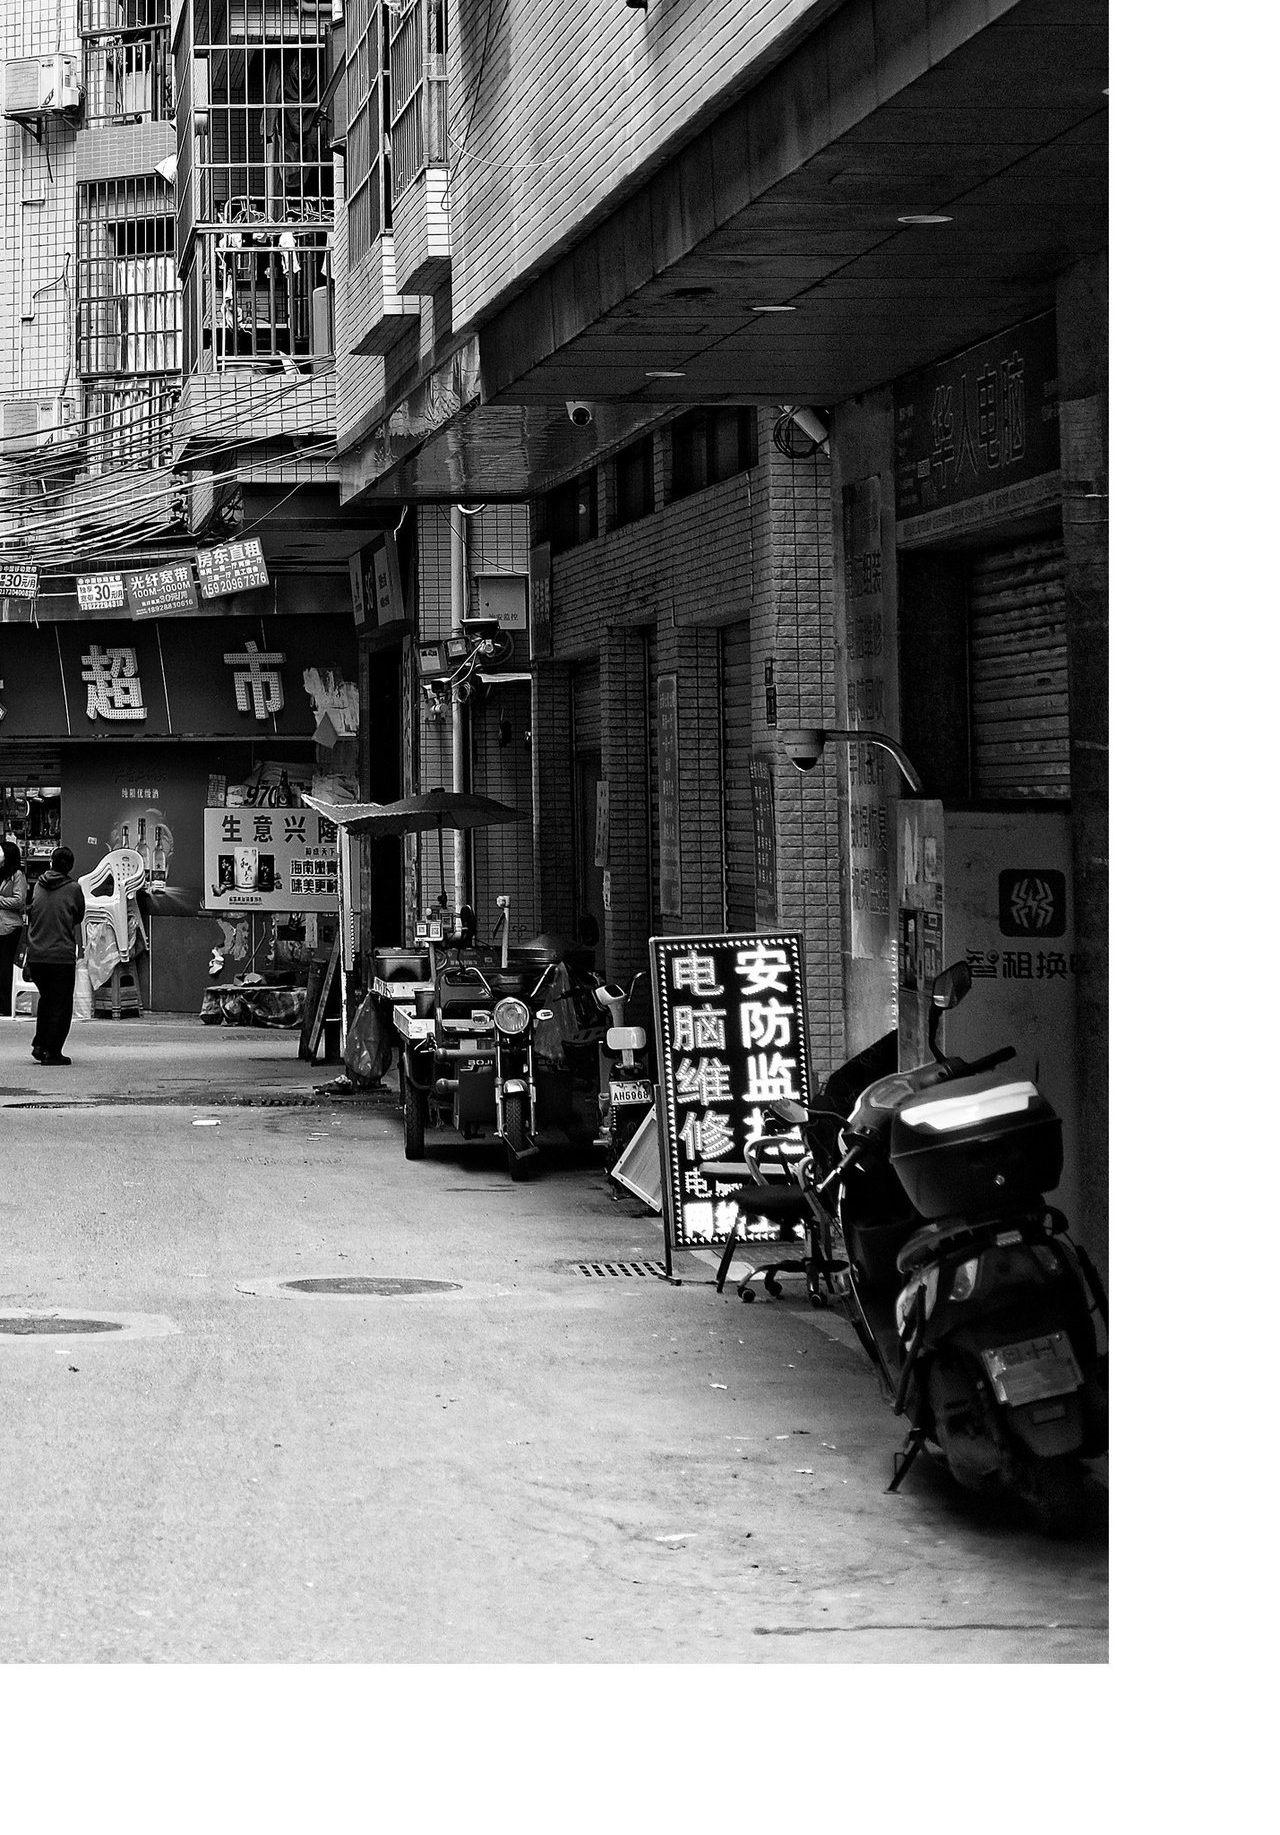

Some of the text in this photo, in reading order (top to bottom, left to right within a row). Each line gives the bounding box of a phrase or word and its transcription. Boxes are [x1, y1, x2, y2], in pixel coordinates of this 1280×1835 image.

[197, 540, 262, 569] 房东直租
[130, 567, 188, 591] 光纤宽带
[132, 580, 191, 599] 100M-1000M
[202, 571, 267, 596] 159 2096 7376
[221, 814, 338, 844] 生意兴隆
[671, 949, 736, 1161] 电脑维修
